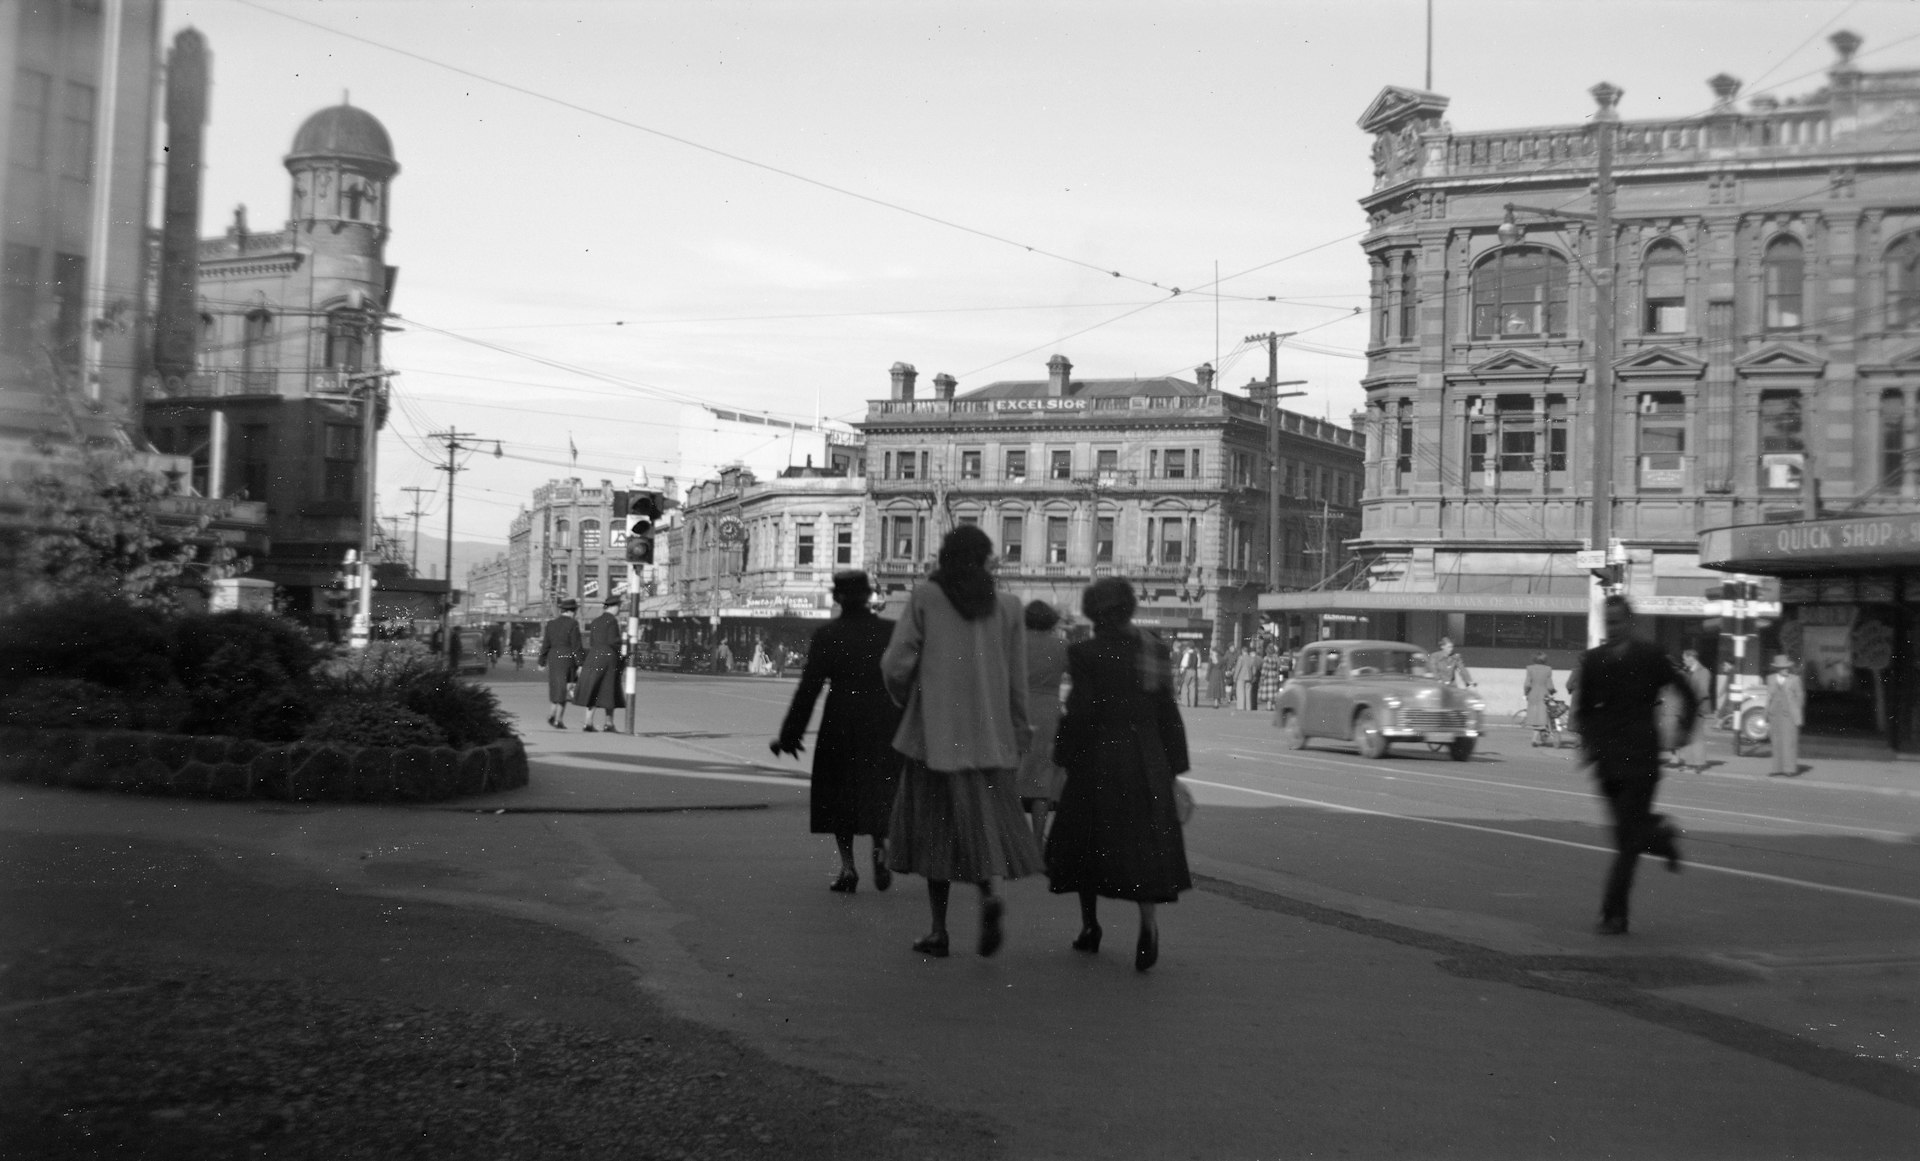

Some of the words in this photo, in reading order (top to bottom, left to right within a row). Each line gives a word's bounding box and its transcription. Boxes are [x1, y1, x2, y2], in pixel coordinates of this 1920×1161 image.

[996, 399, 1087, 411] EXCELSIOR
[1777, 528, 1831, 554] QUICK
[1842, 523, 1892, 547] SHOP
[1454, 596, 1484, 607] BANK
[1491, 597, 1508, 607] OF
[1513, 598, 1576, 609] AUSTRALIA
